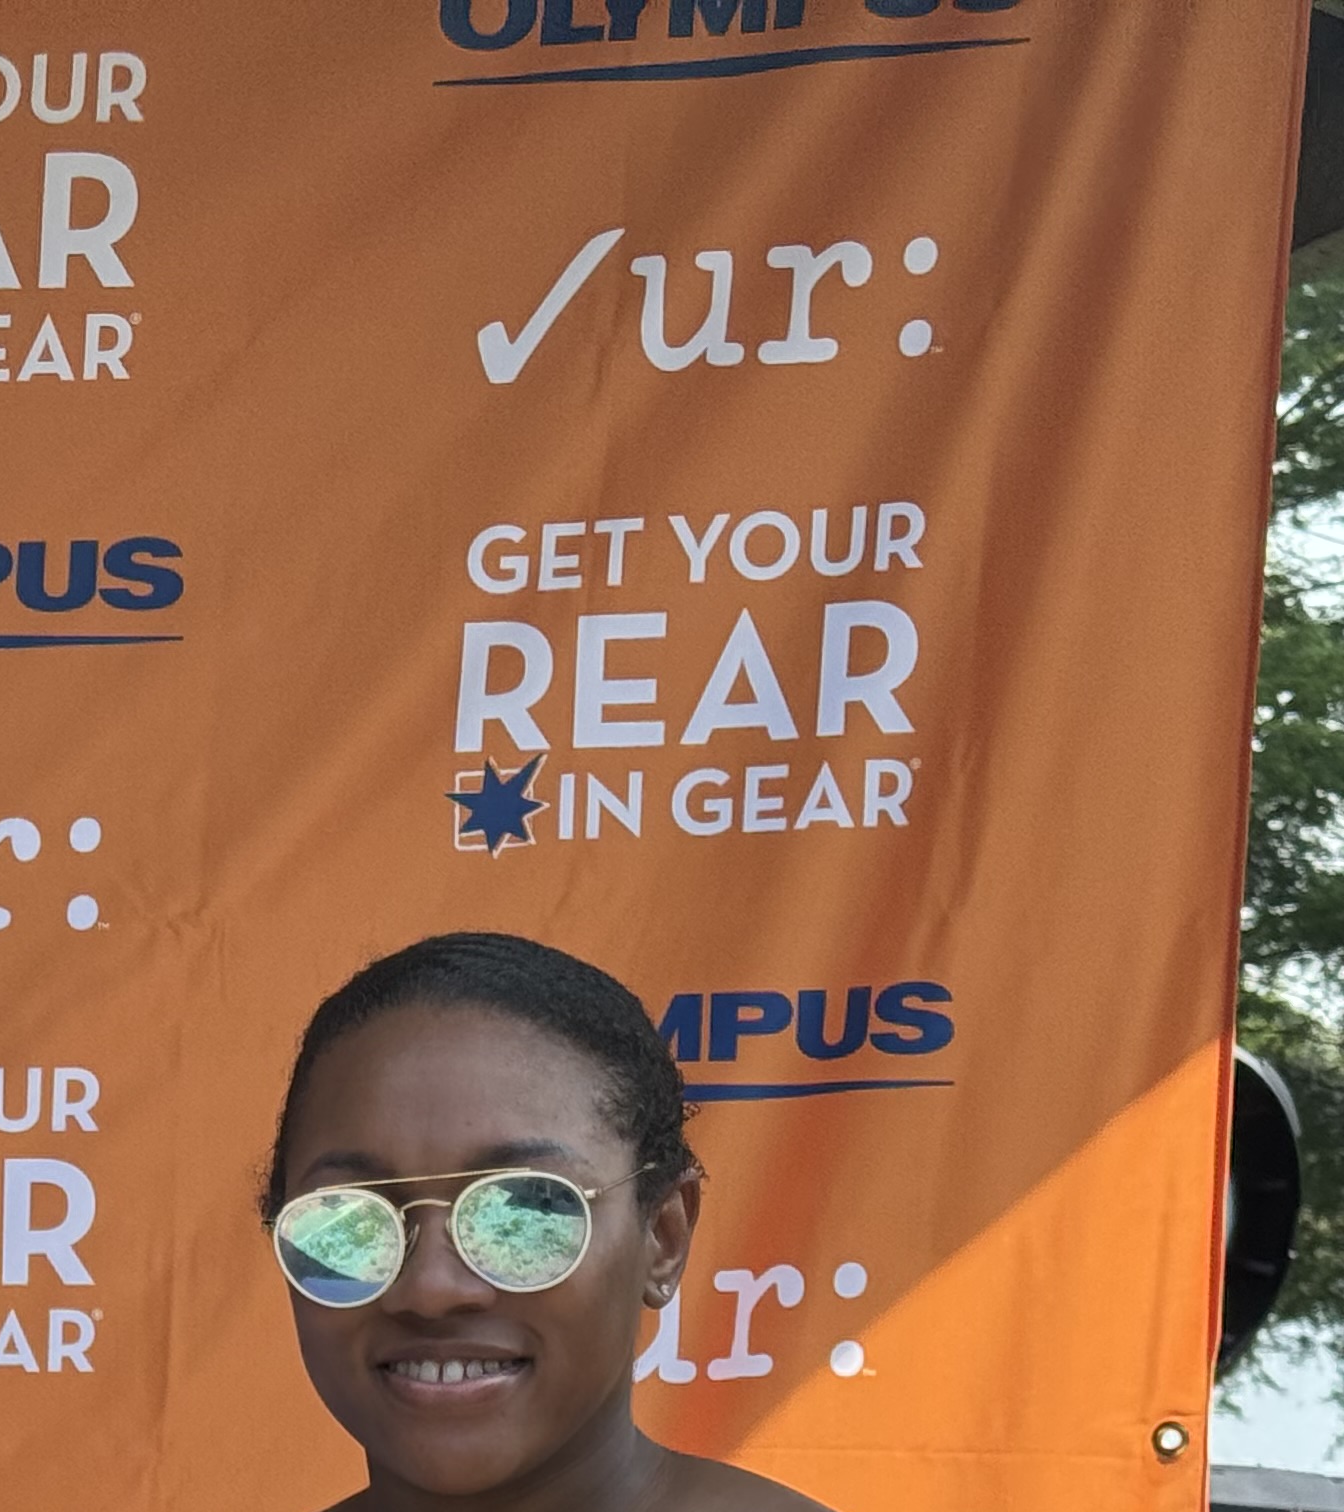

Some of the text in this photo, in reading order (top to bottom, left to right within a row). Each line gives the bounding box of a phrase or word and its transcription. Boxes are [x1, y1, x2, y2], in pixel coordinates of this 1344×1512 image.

[468, 501, 926, 594] GET YOUR
[454, 600, 919, 752] REAR
[558, 759, 913, 839] IN GEAR
